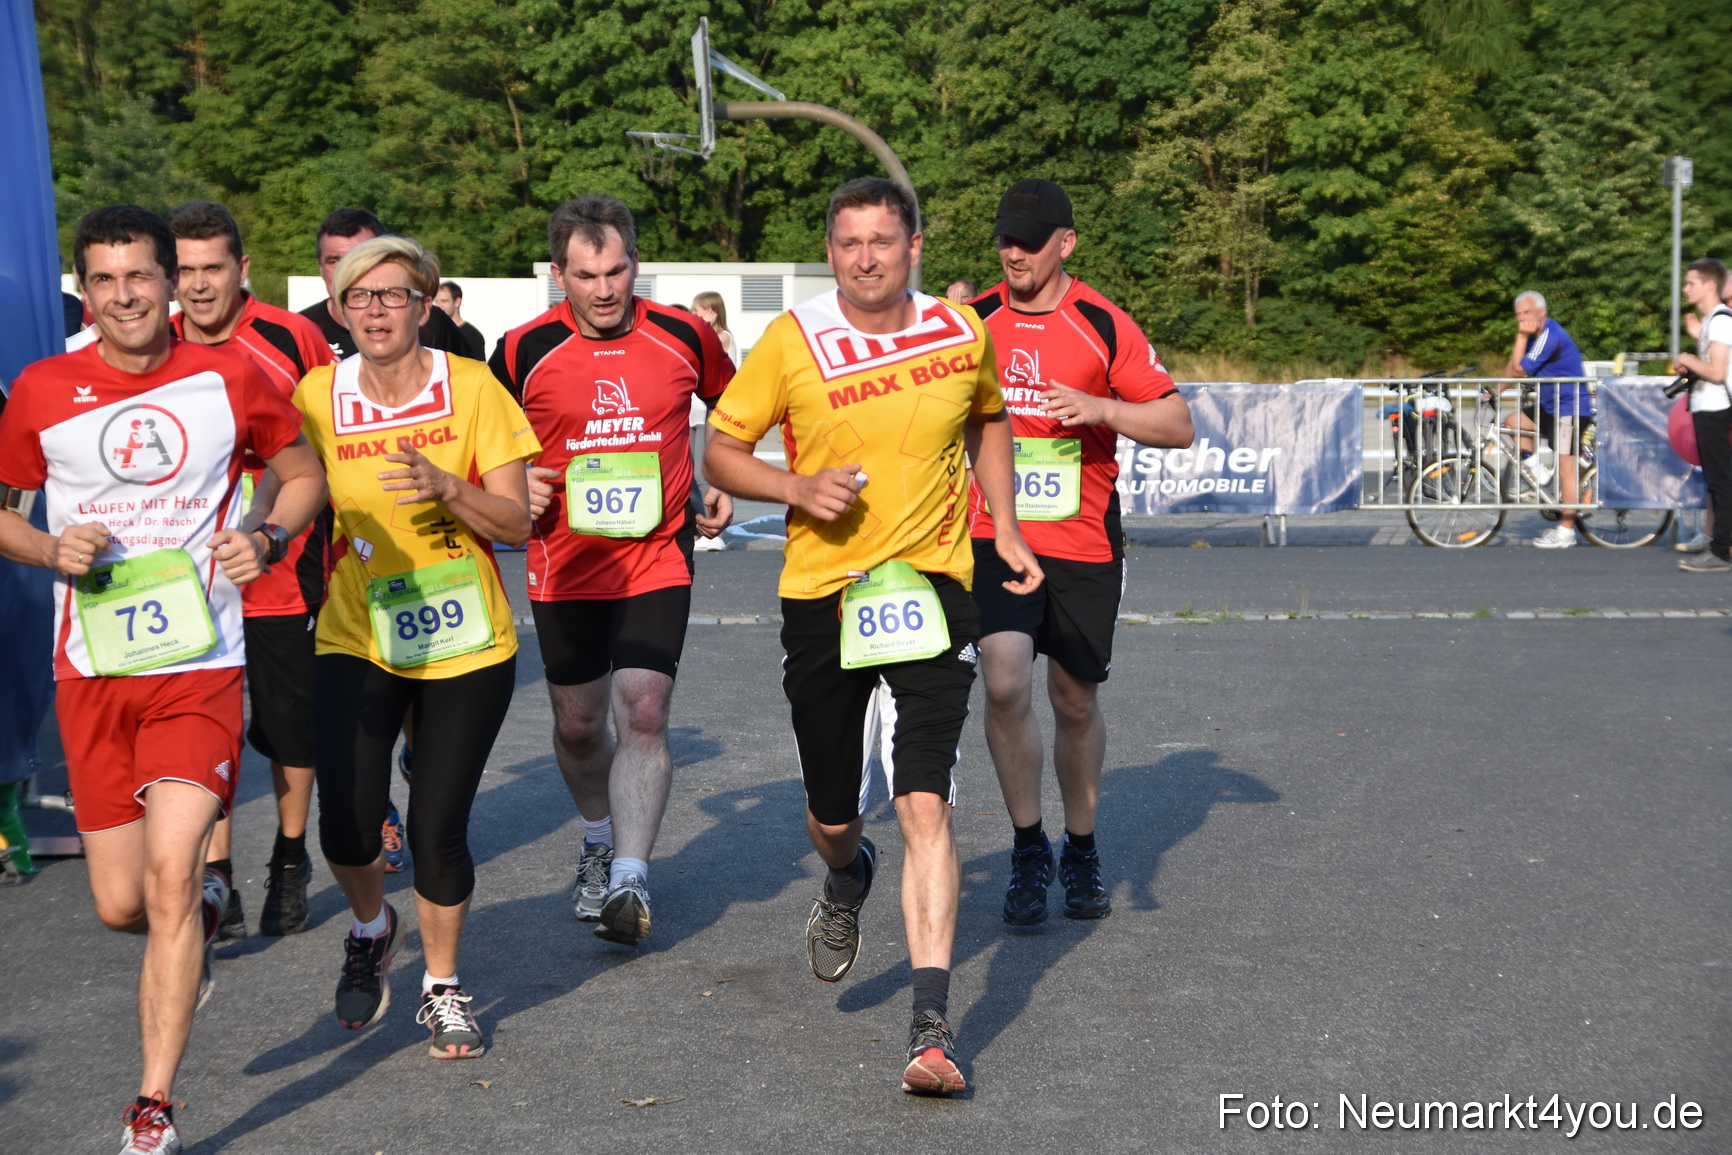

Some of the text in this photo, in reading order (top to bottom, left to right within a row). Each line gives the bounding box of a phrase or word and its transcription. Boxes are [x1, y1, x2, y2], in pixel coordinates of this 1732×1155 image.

[827, 353, 979, 410] MAX BÖGL
[73, 394, 98, 403] erima
[1001, 387, 1049, 403] MEYE
[585, 416, 645, 434] MEYER
[336, 426, 458, 461] MAX BÖGL
[566, 432, 662, 451] Fördertechnik GmbH
[1115, 478, 1266, 494] AUTOMOBILE
[78, 496, 209, 515] LAUFEN MIT HERZ
[586, 487, 642, 514] 967
[109, 517, 134, 527] Heck
[144, 517, 159, 526] Dr.
[162, 517, 196, 527] Röschl
[114, 600, 169, 641] 73
[396, 599, 464, 640] 899
[857, 600, 924, 637] 866
[124, 644, 160, 659] Johannes
[160, 638, 179, 649] Heck
[418, 640, 440, 650] Margit
[870, 642, 896, 650] Richard
